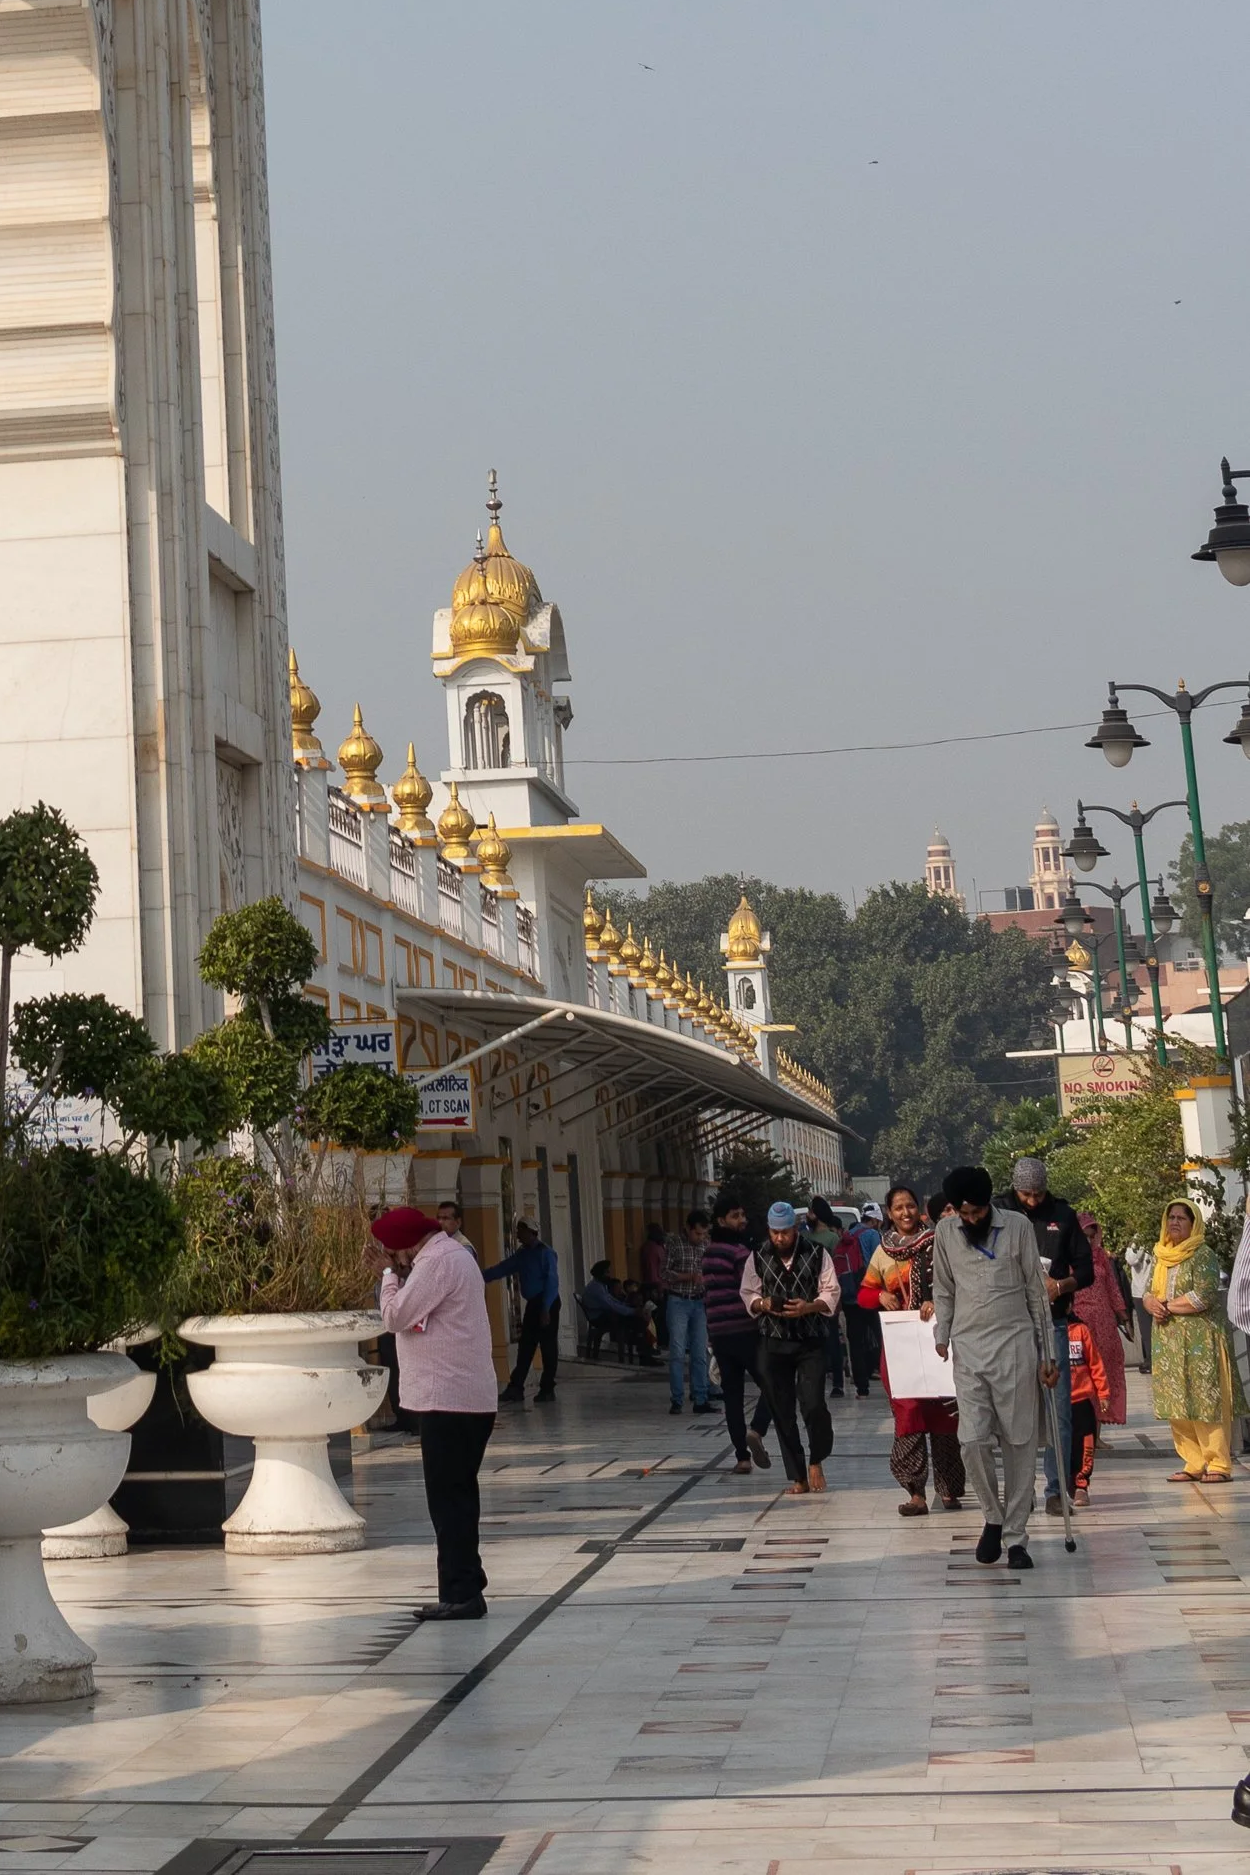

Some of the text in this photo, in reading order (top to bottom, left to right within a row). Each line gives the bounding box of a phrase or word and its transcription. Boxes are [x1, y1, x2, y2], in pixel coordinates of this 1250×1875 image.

[353, 1032, 392, 1054] ਘਰ
[1064, 1082, 1082, 1093] NO
[443, 1098, 470, 1113] SCAN
